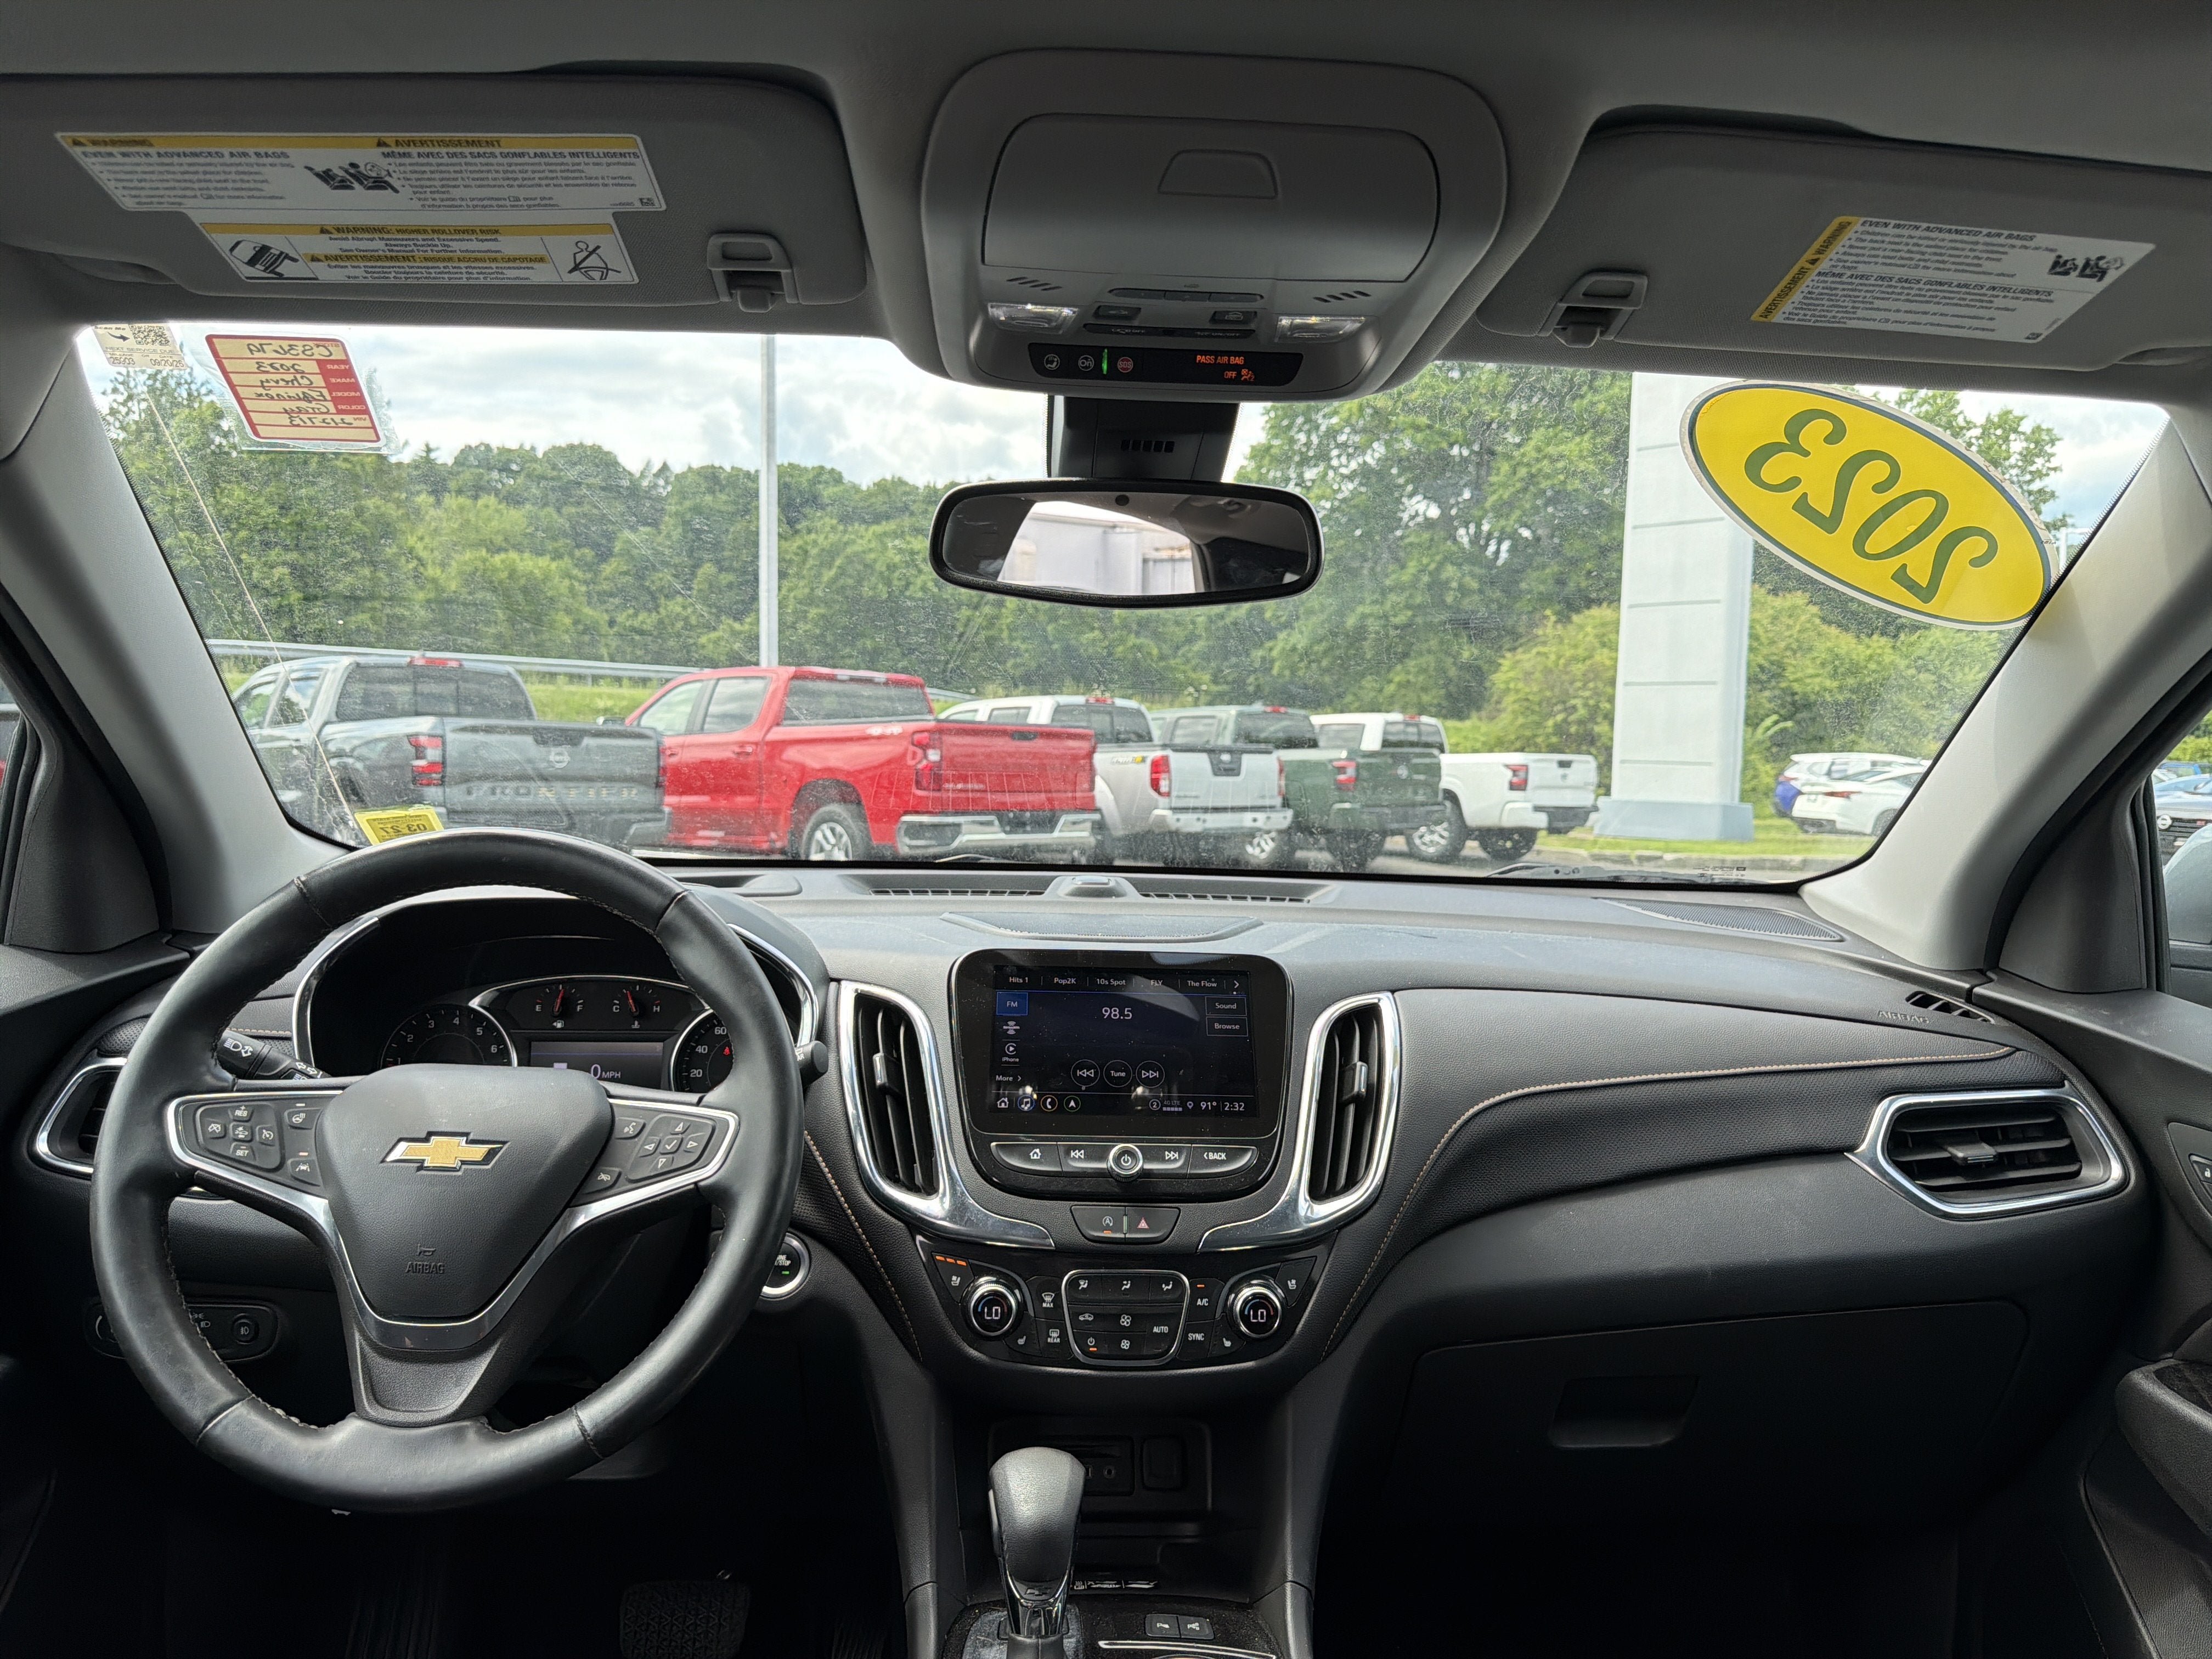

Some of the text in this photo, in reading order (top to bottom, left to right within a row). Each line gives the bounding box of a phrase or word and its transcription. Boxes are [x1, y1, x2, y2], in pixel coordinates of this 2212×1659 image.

[395, 139, 501, 148] AVERTISSEMENT
[1860, 220, 1891, 229] EVEN
[1892, 222, 1921, 231] WITH
[1922, 225, 1983, 237] ADVANCED
[2004, 233, 2037, 242] BAGS
[1812, 221, 1852, 256] WARNING
[1815, 270, 1846, 279] MÊME
[1874, 275, 1895, 283] DES
[1895, 277, 1923, 285] SACS
[1923, 279, 1987, 291] GONFLABLES
[1985, 285, 2054, 297] INTELLIGENTS
[1759, 266, 1811, 319] AVERTISSEMENT
[110, 357, 184, 367] 25903 09/20/26
[1196, 354, 1245, 365] PASS AIR BAG
[1119, 360, 1133, 369] SOS
[1223, 371, 1238, 379] OFF
[1054, 977, 1076, 986] Pop2K
[1102, 1007, 1133, 1019] 98.5
[428, 1020, 435, 1028] 3
[453, 1017, 459, 1025] 4
[476, 1027, 483, 1035] 5
[714, 1026, 727, 1035] 60
[491, 1045, 497, 1053] 6
[696, 1045, 708, 1053] 40
[591, 1064, 601, 1079] 0
[690, 1069, 703, 1077] 20
[1200, 1101, 1217, 1110] 91°
[1224, 1102, 1245, 1111] 2:32
[1209, 1152, 1227, 1160] BACK
[405, 1261, 445, 1274] AIRBAG
[1197, 1298, 1209, 1306] A/C
[985, 1306, 1001, 1320] LO
[1250, 1309, 1266, 1322] LO
